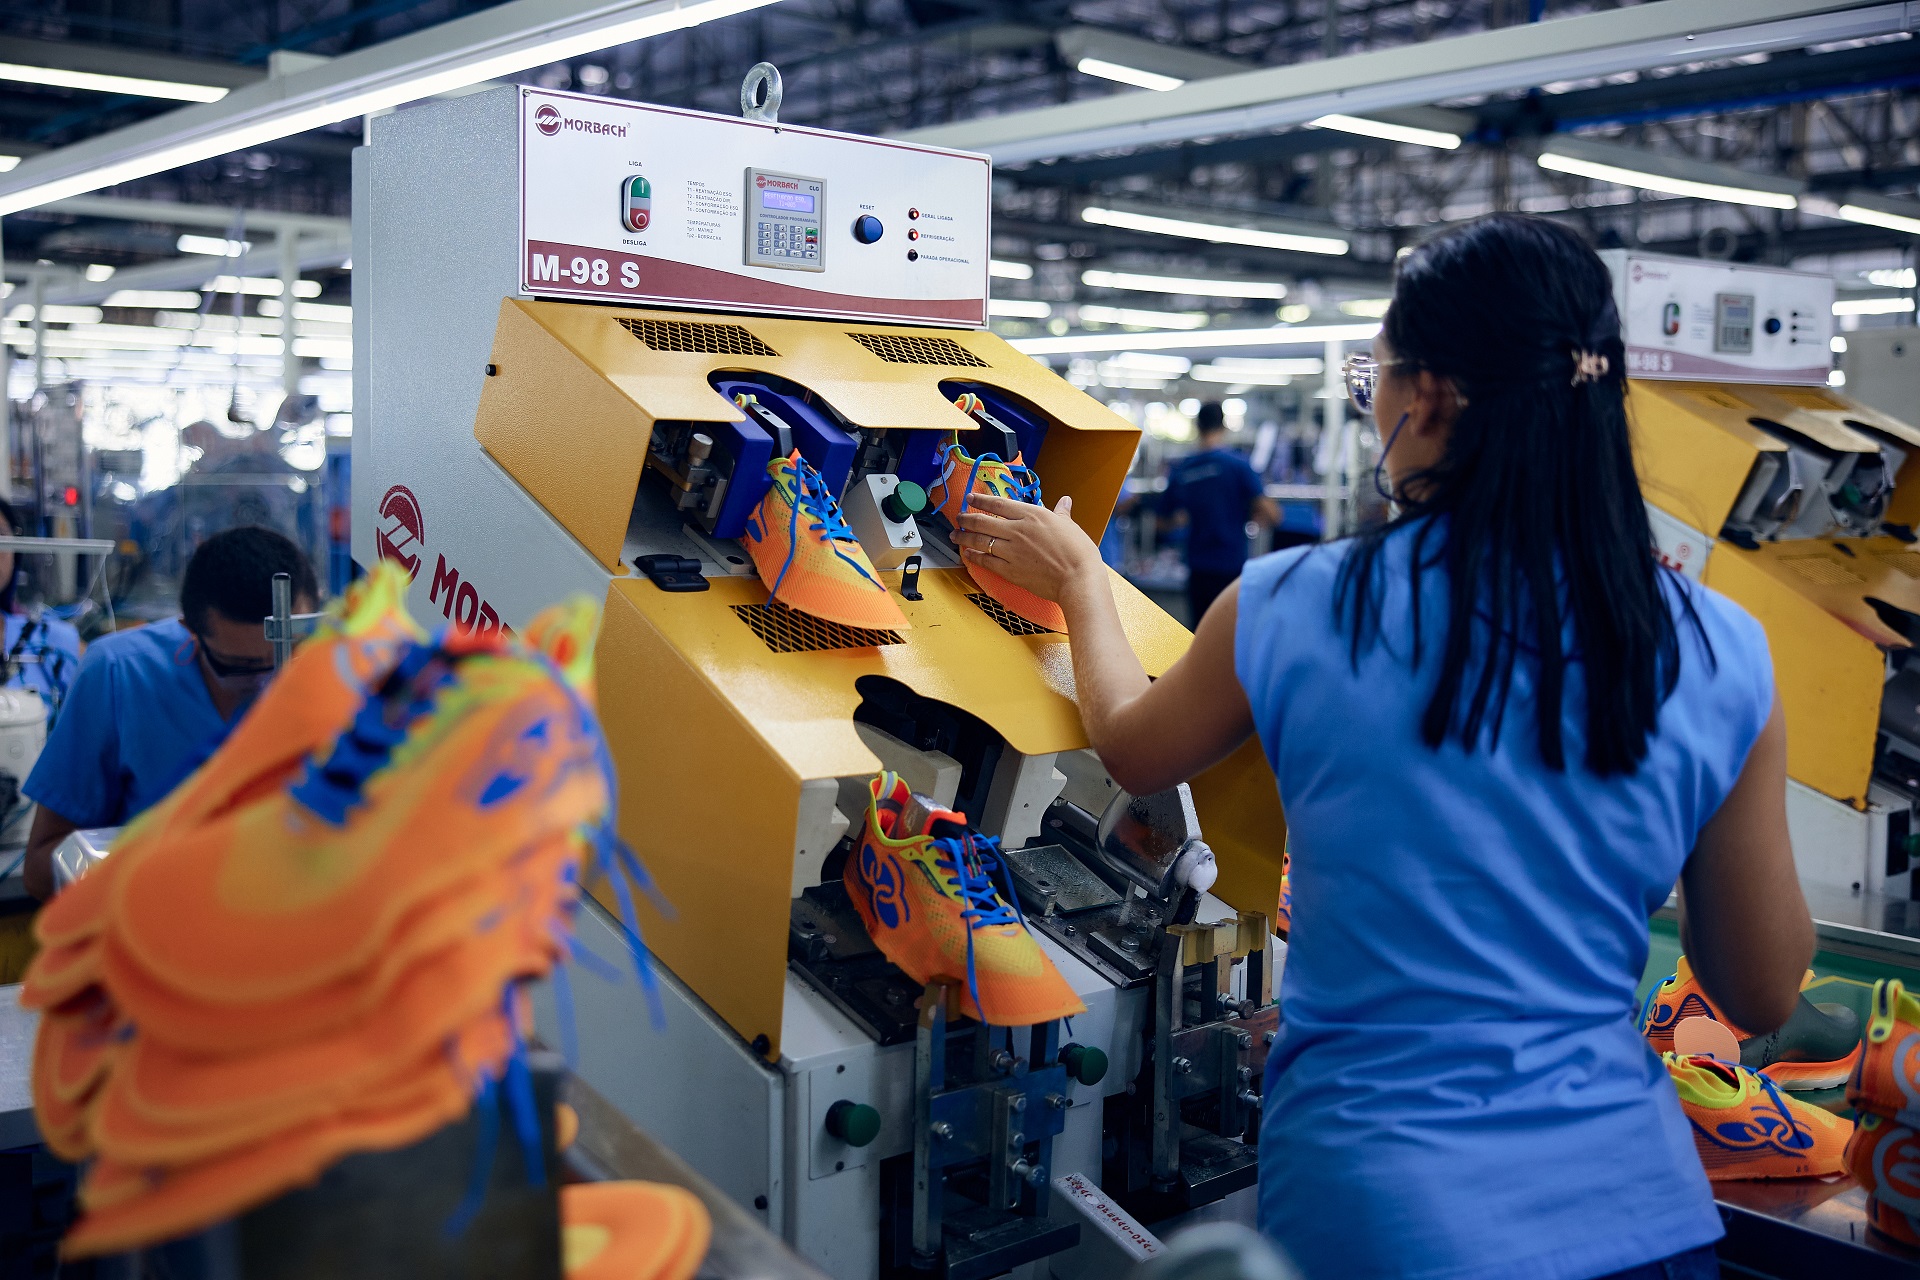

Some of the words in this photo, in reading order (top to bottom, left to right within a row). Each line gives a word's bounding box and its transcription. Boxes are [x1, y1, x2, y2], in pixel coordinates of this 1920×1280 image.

[564, 117, 627, 138] MORBACH
[767, 179, 799, 190] MORBACH
[759, 213, 788, 221] CONTROLADOR
[789, 216, 818, 224] PROGRAMÁVEL
[937, 214, 954, 222] LIGADA
[622, 238, 647, 246] DESLIGA
[920, 233, 955, 242] REFRIGERAÇÃO
[939, 256, 970, 264] OPERACIONAL
[533, 253, 610, 287] M-98
[620, 261, 641, 289] S
